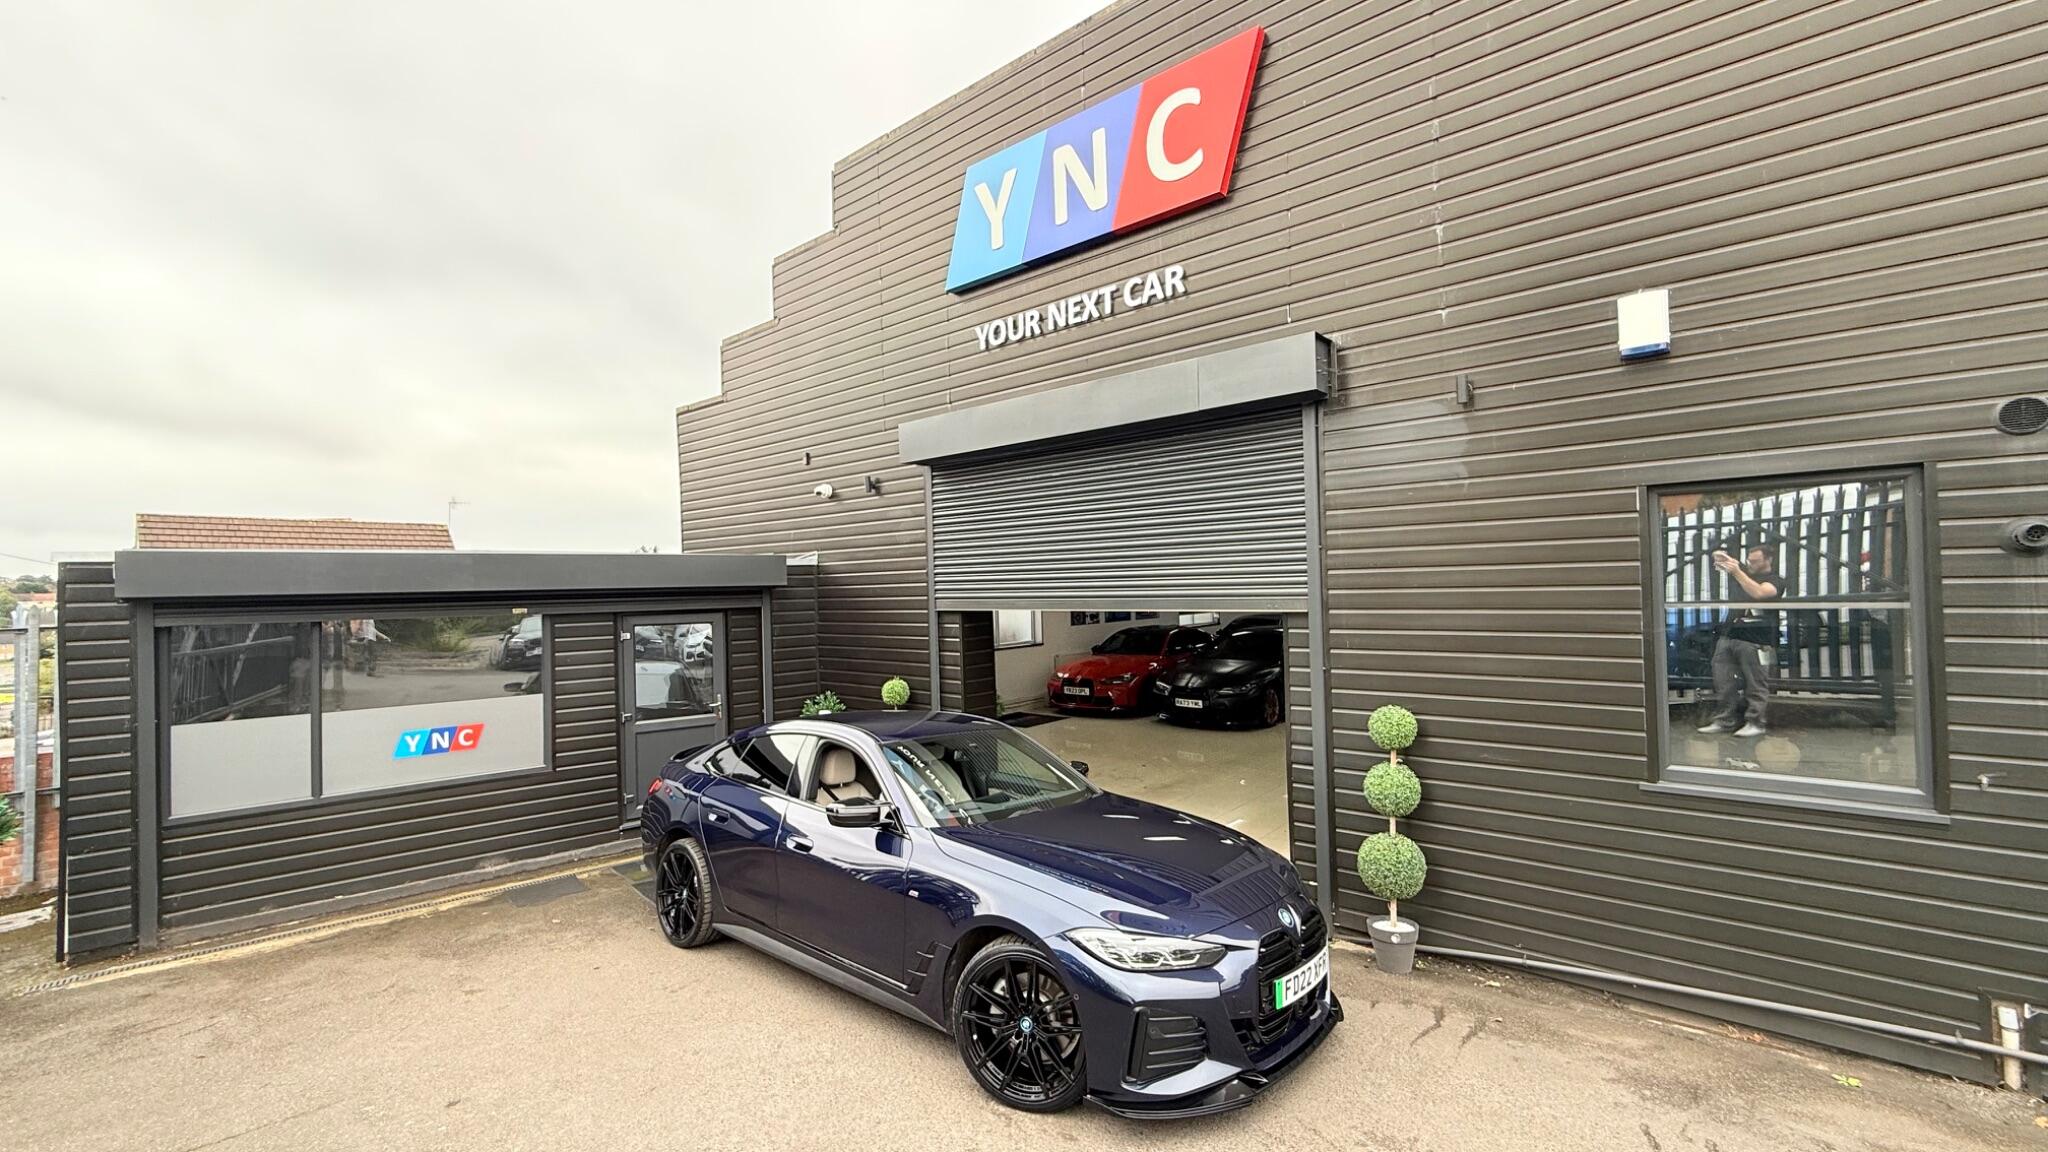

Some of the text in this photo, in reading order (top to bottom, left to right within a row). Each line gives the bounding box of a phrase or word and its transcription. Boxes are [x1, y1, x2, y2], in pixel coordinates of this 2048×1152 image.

[974, 87, 1204, 250] YNC
[974, 264, 1187, 351] YOUR NEXT CAR
[404, 728, 475, 753] YNC
[1285, 966, 1313, 1001] FD22
